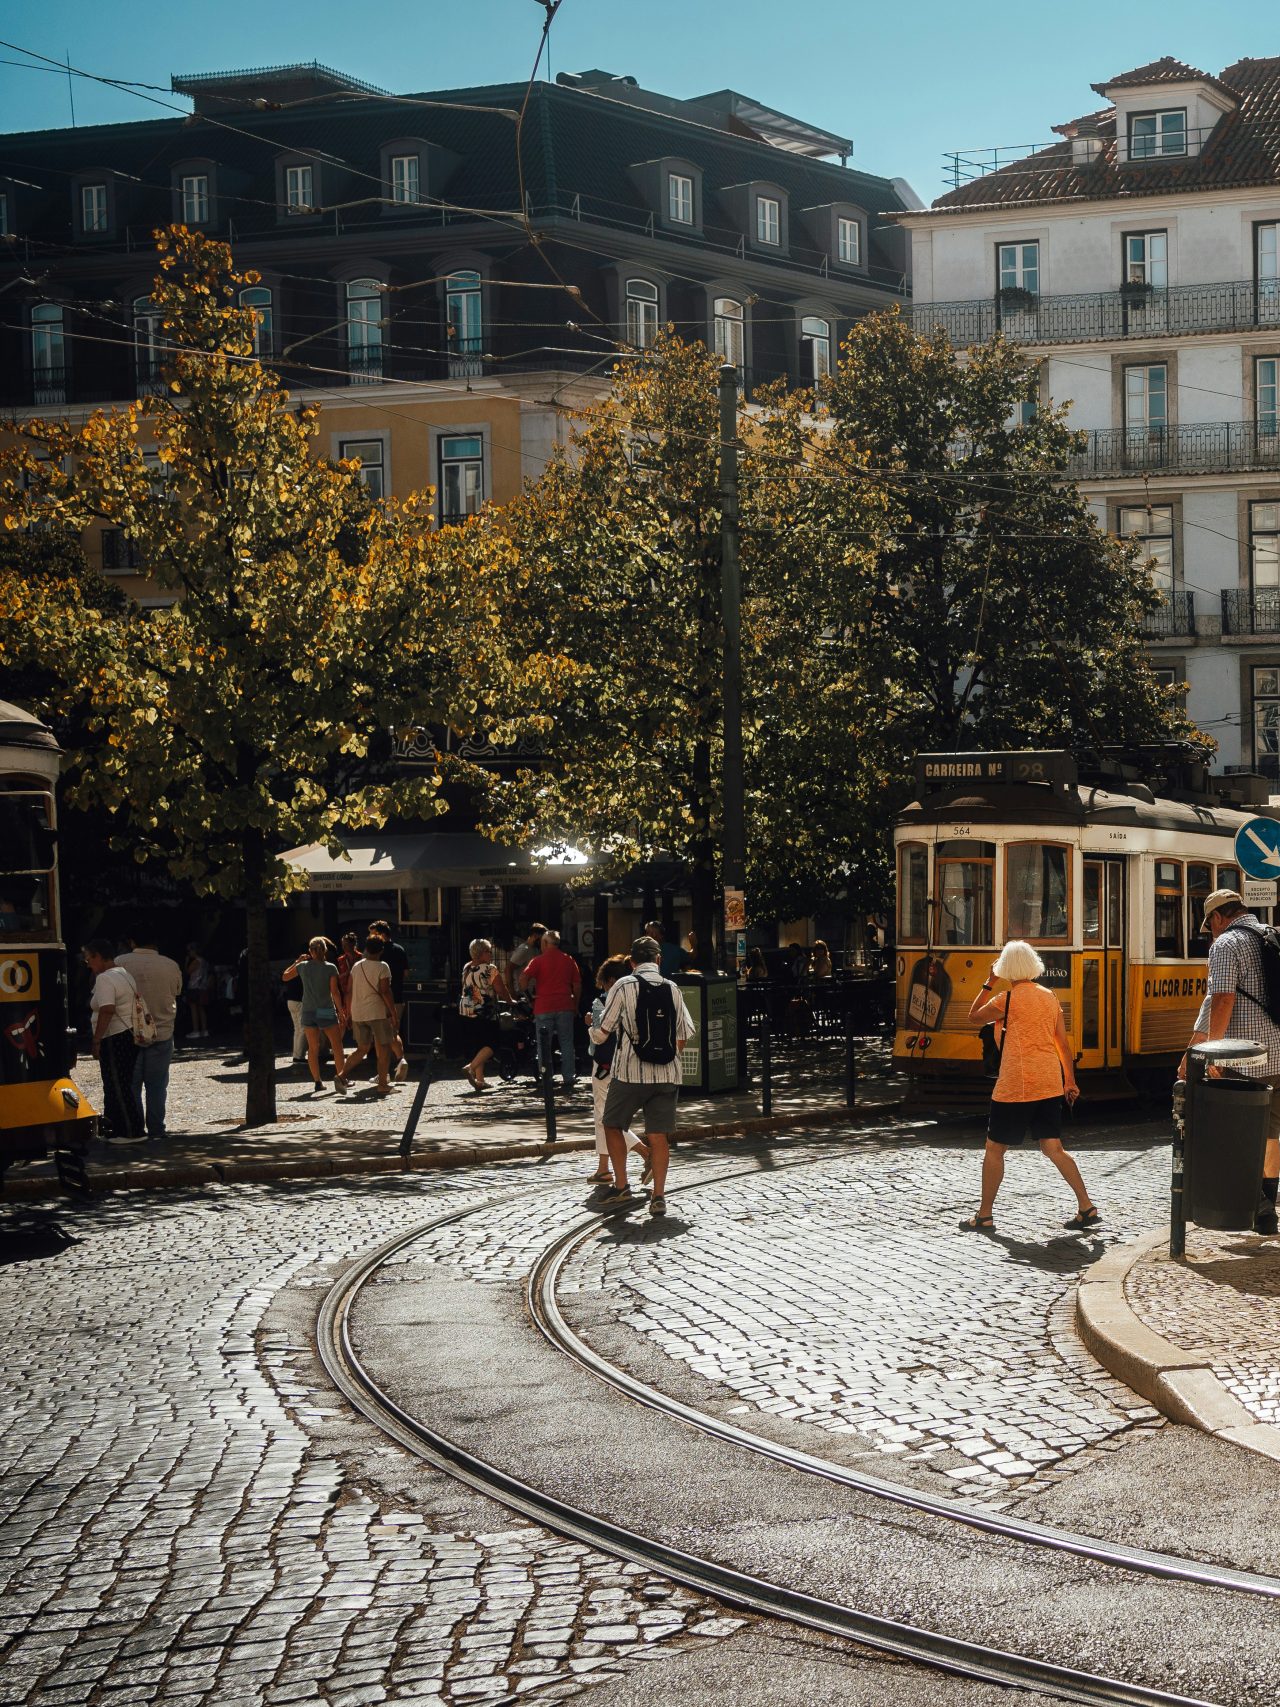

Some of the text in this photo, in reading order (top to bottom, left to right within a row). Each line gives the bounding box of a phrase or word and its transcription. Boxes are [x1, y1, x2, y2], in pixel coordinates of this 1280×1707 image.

[925, 763, 982, 777] CARREIRA
[953, 826, 970, 835] 564
[1144, 978, 1207, 998] O LICOR DE PO
